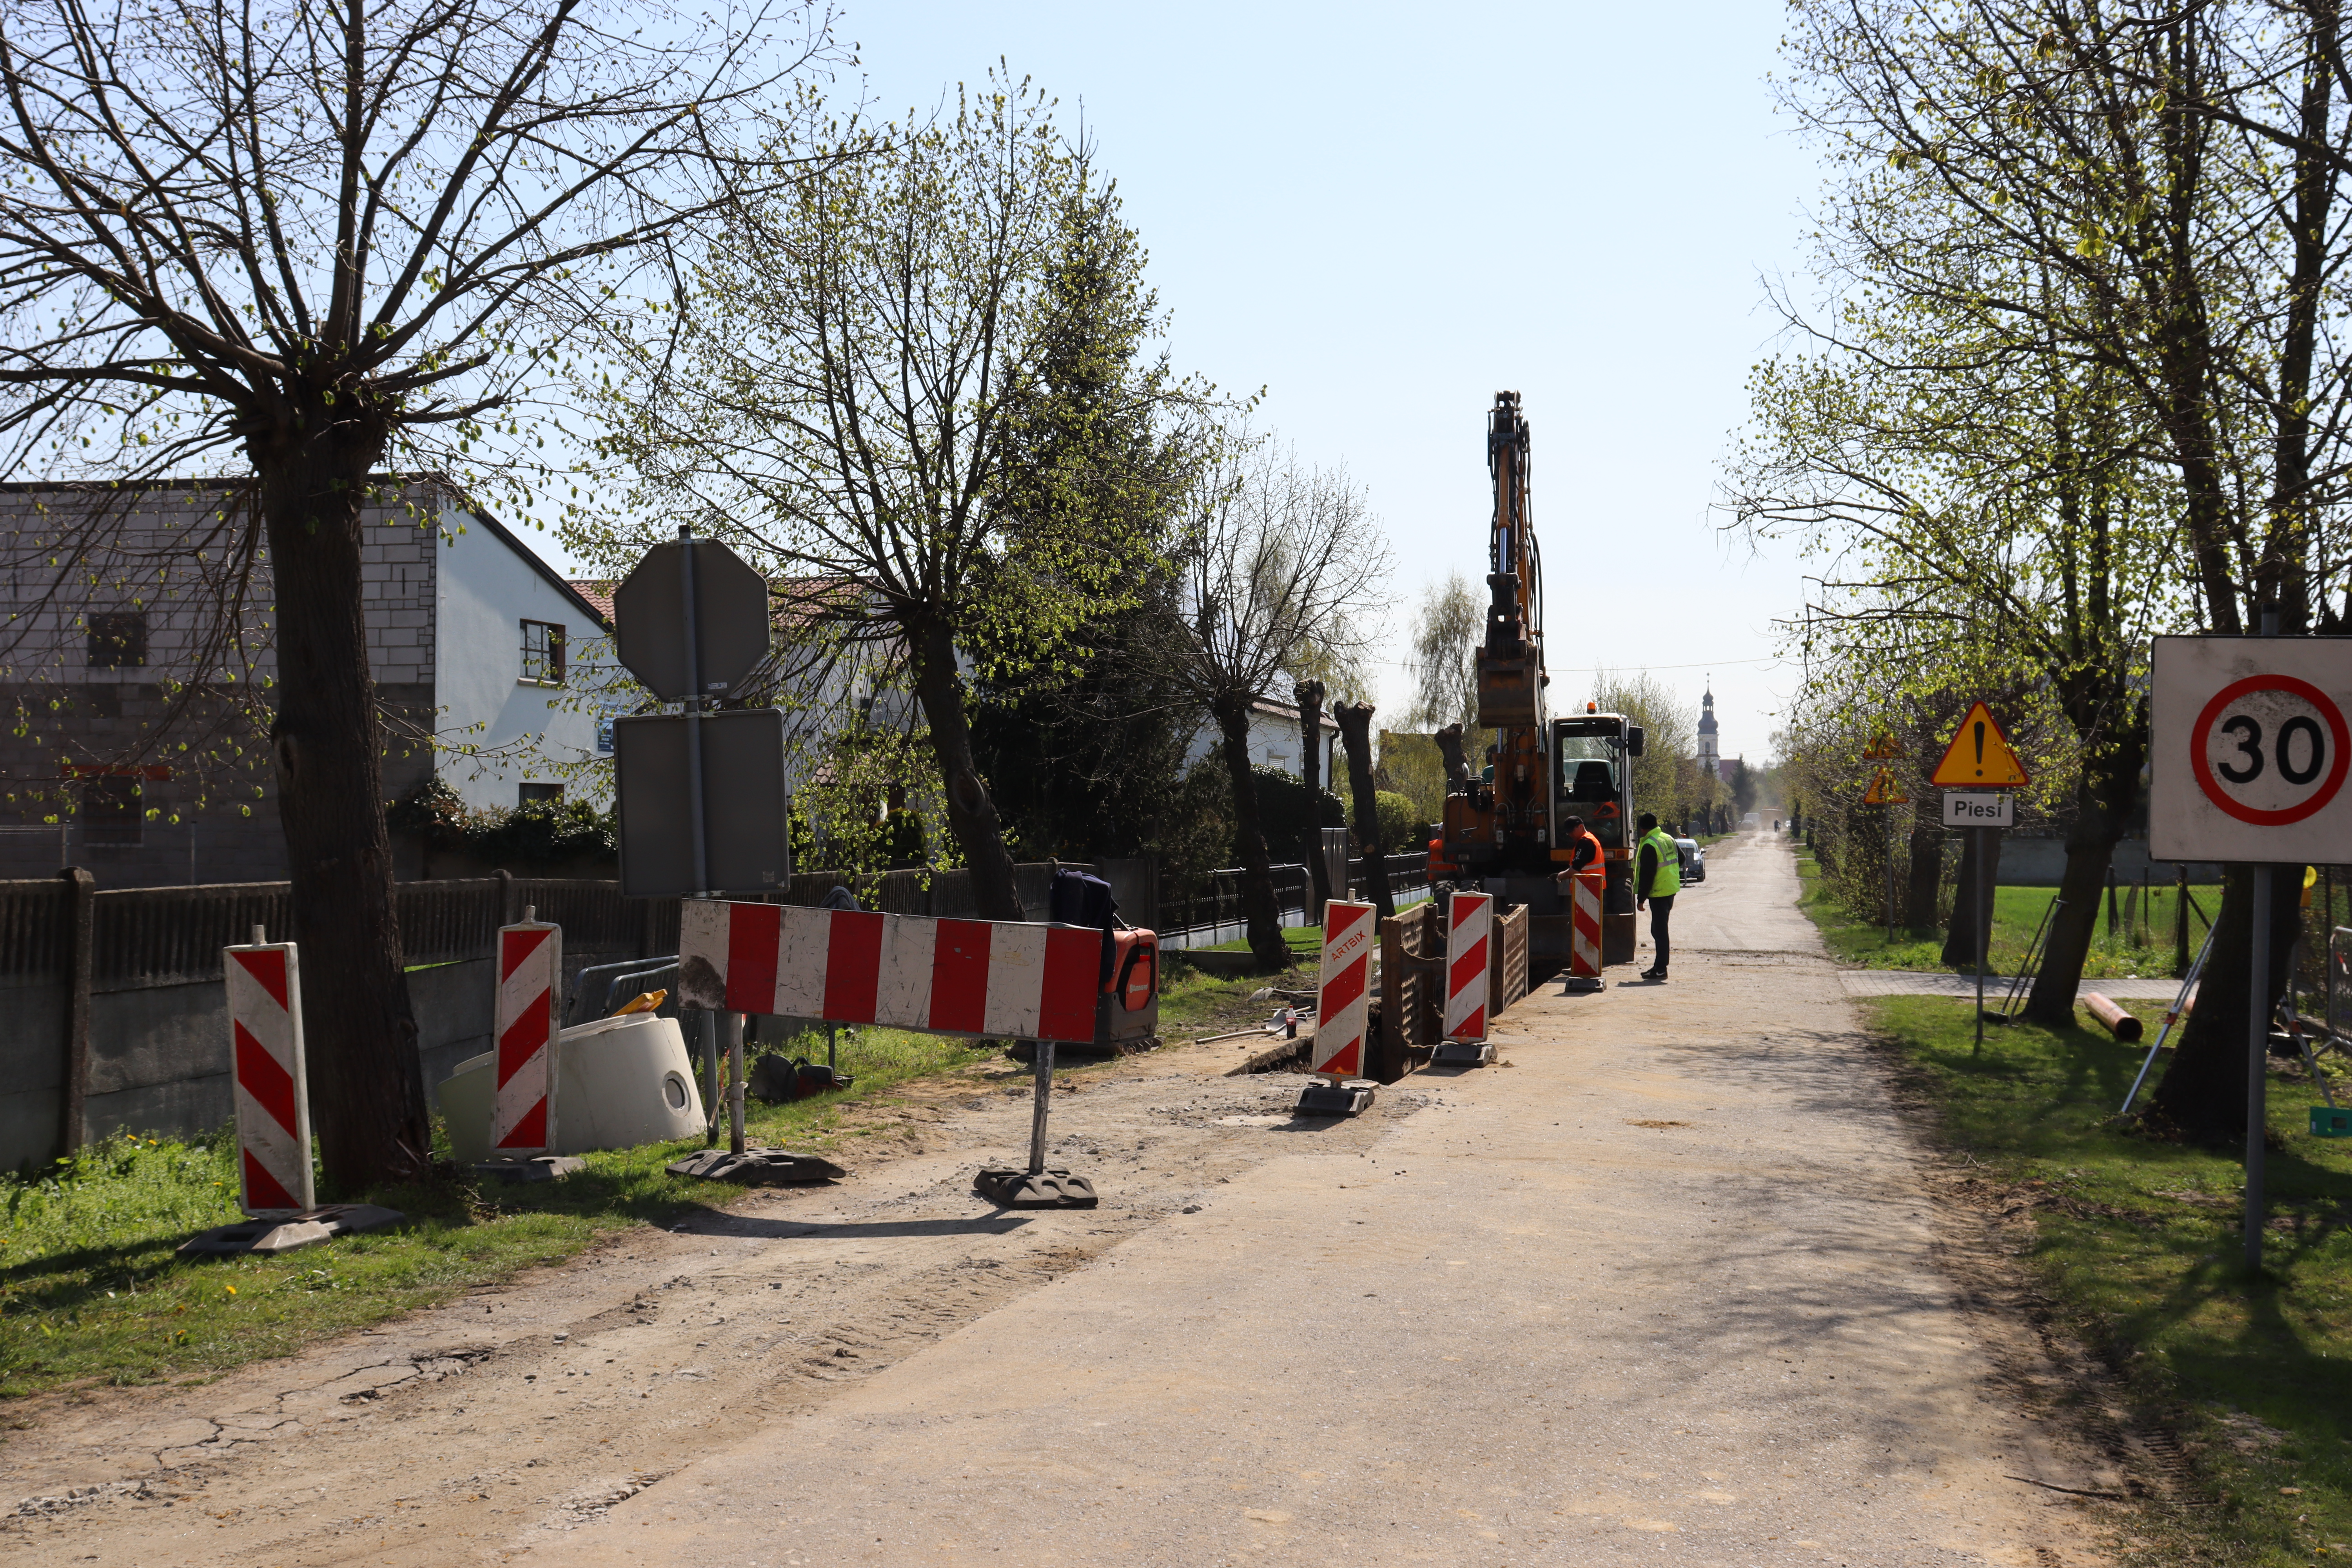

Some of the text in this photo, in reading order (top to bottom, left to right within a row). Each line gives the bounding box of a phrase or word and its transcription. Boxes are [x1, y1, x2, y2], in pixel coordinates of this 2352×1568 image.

[2218, 715, 2325, 785] 30
[1955, 800, 2002, 818] Piesi
[1331, 930, 1367, 962] ARTBIX
